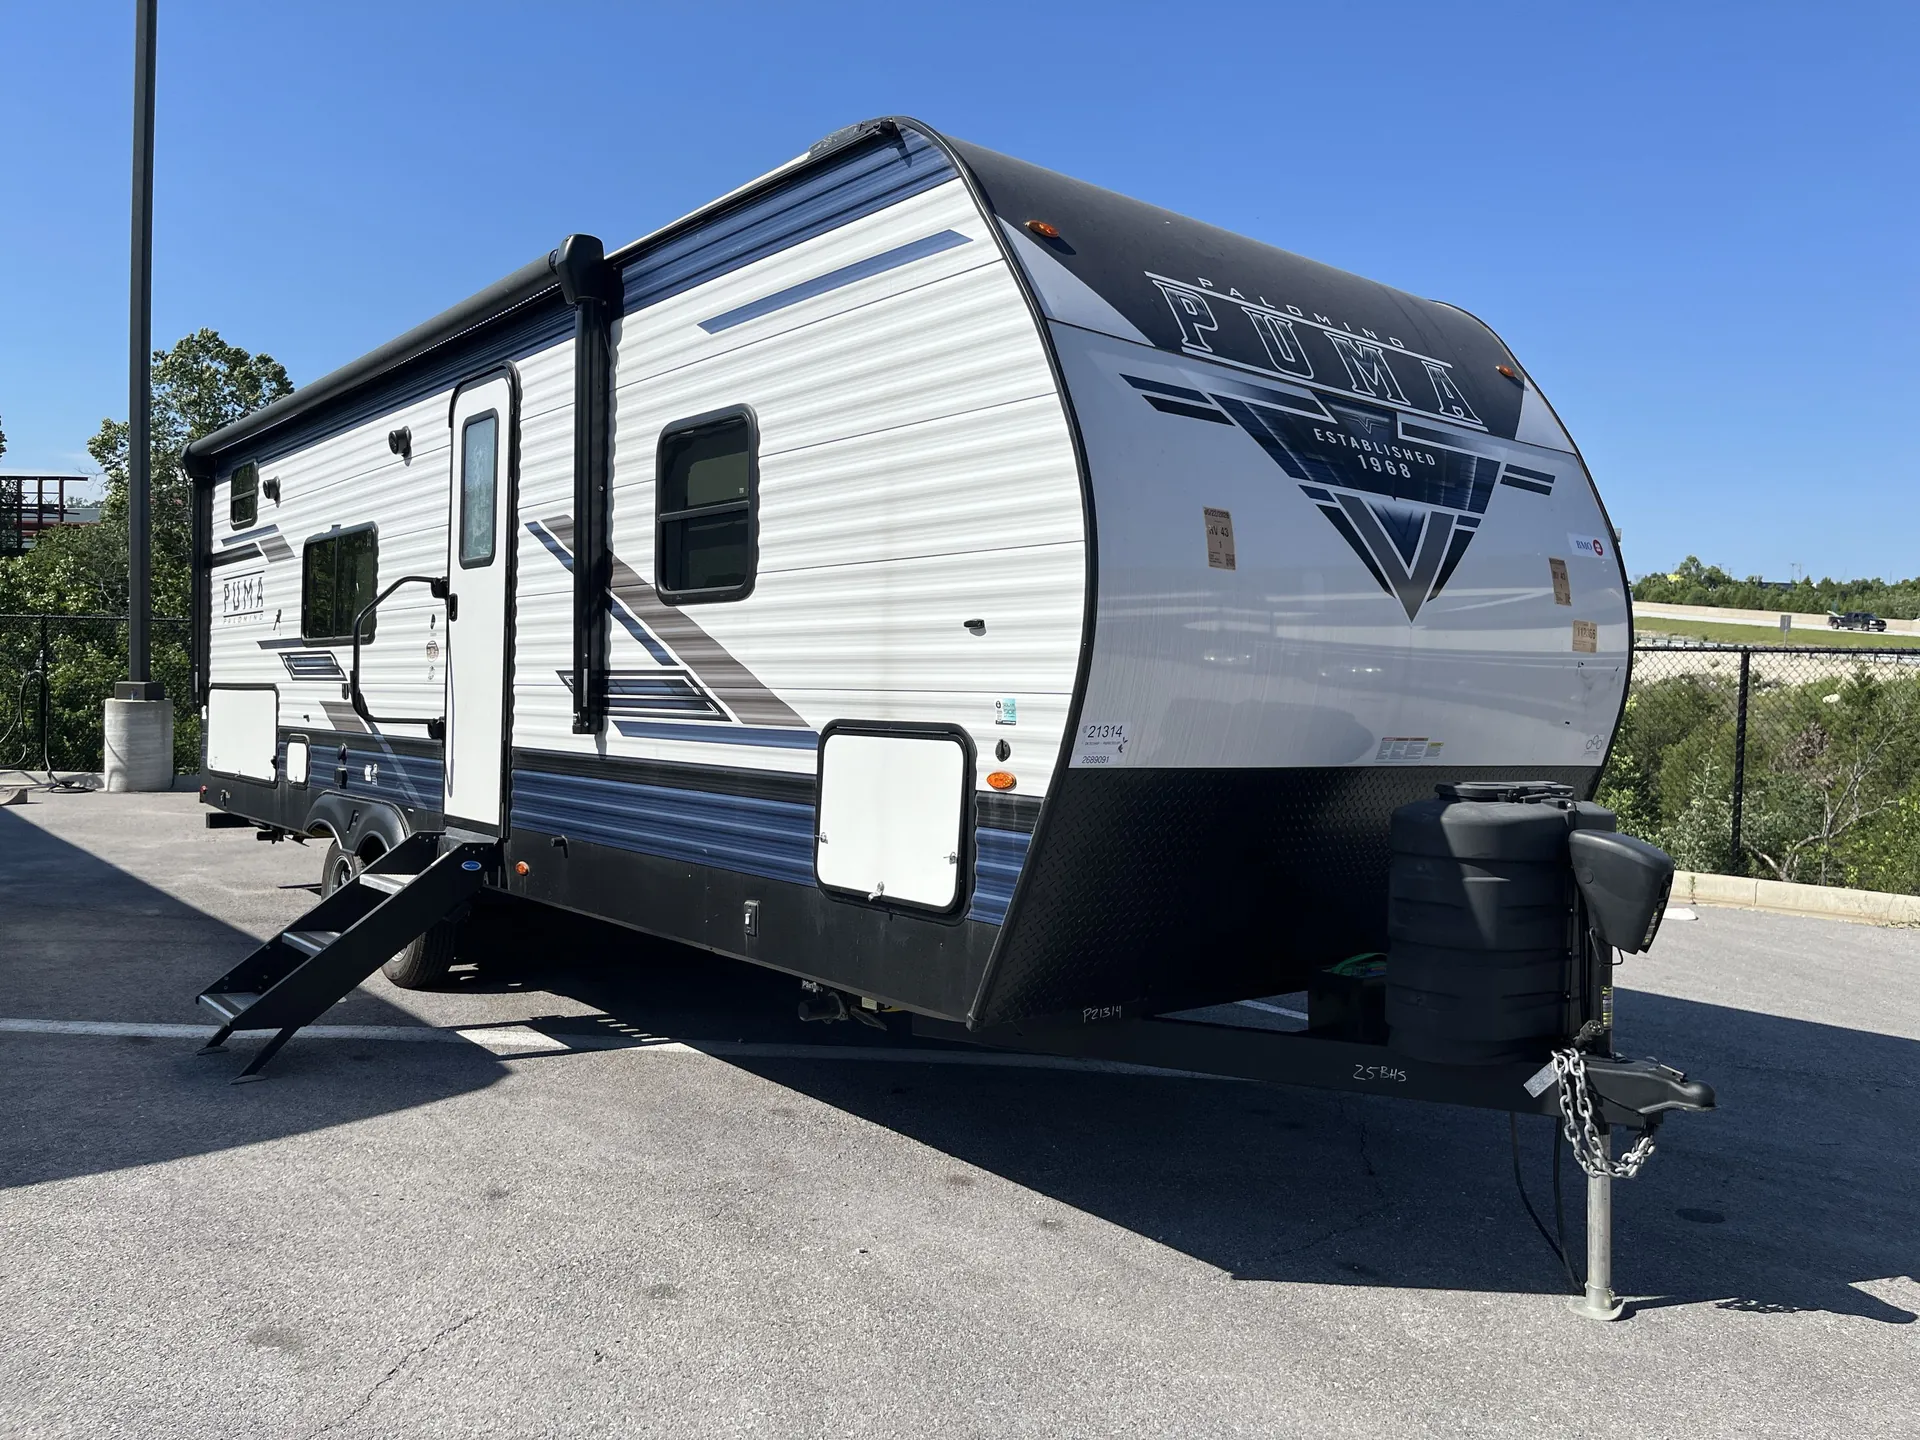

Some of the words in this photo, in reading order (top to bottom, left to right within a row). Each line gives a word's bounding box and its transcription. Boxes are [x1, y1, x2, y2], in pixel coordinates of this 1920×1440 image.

[1197, 276, 1405, 348] PALOMINO
[1152, 279, 1484, 425] PUMA
[1313, 428, 1436, 466] ESTABLISHED
[1357, 454, 1412, 479] 1968
[223, 577, 264, 613] PUMA
[223, 613, 264, 625] PALOMINO
[1087, 725, 1123, 738] 21314
[1083, 1005, 1122, 1024] P21314
